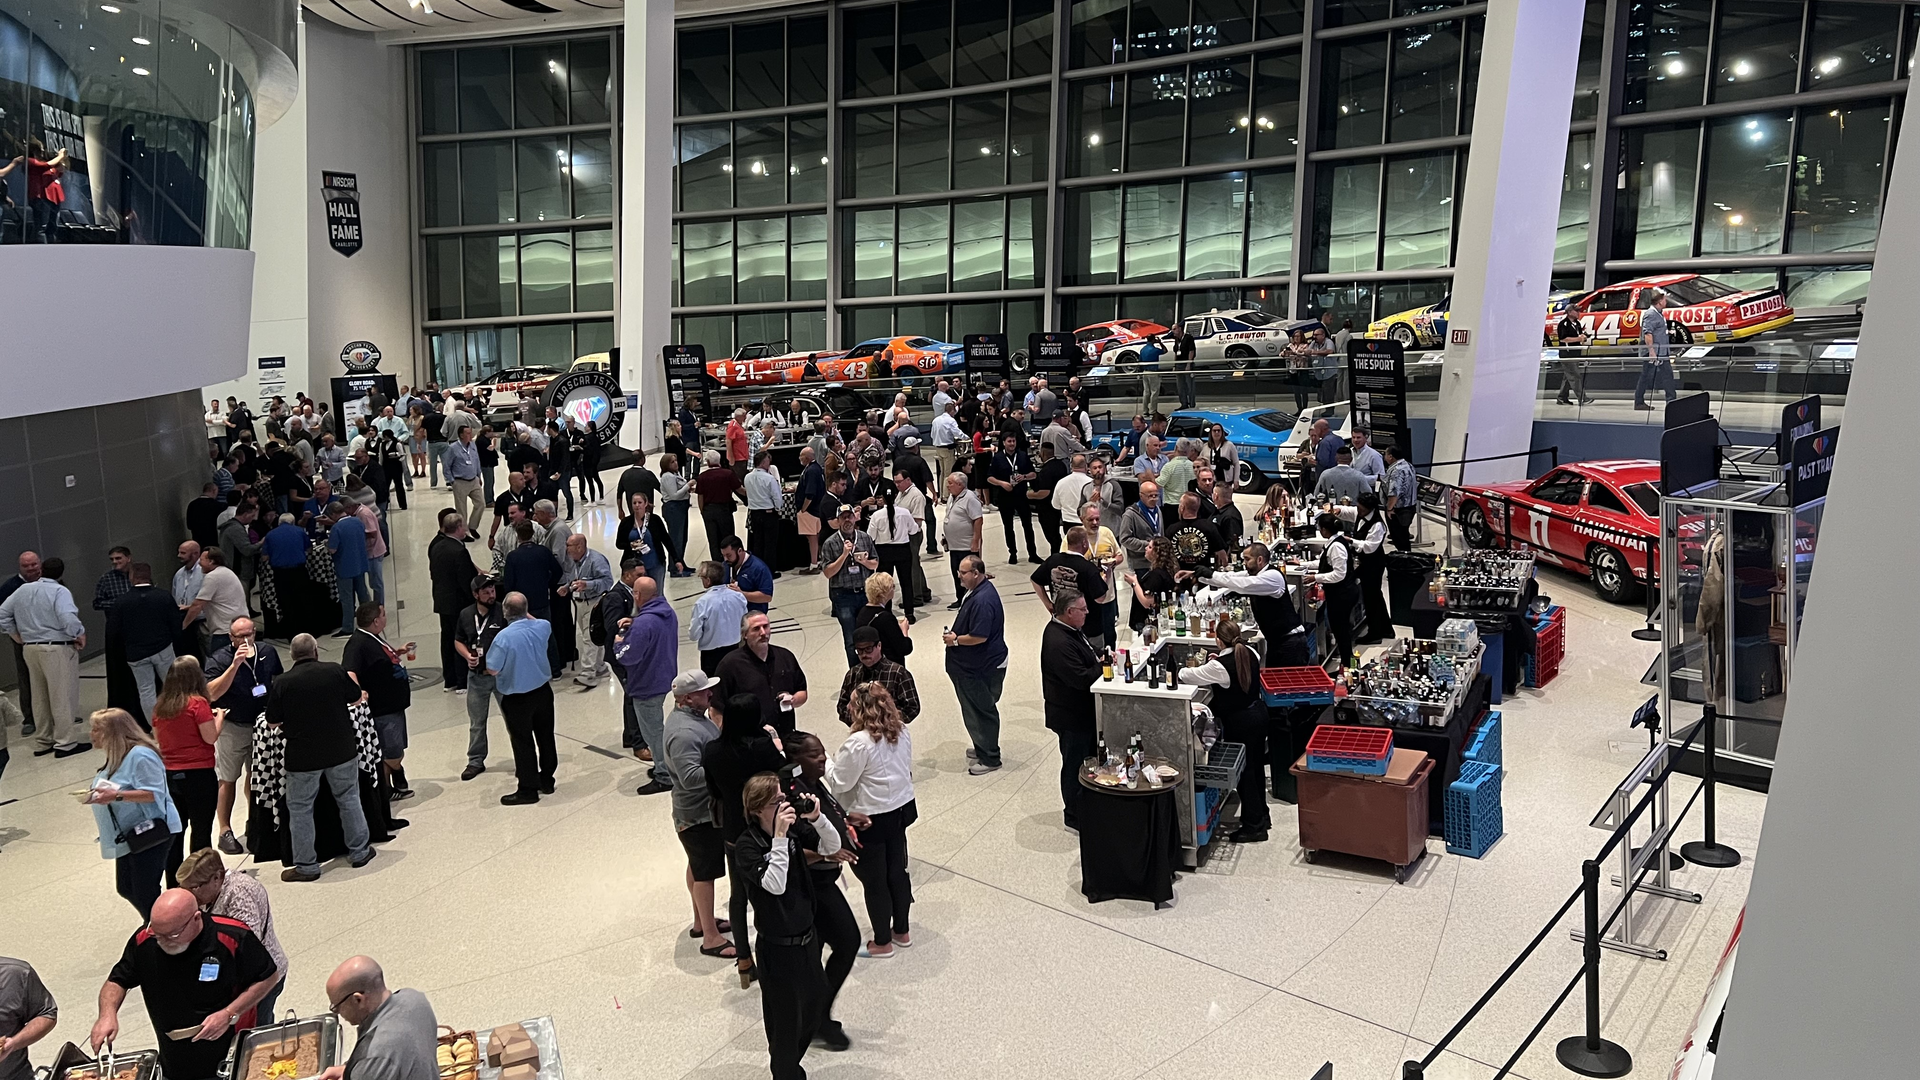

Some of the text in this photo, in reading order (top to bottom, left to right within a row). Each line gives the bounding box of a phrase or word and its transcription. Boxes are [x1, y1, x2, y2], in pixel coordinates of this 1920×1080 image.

[332, 176, 355, 189] NASCAR
[328, 202, 358, 218] HALL
[331, 224, 360, 240] FAME
[1742, 296, 1781, 317] PENROSE
[1662, 307, 1714, 324] NROSE
[1233, 331, 1266, 340] NEWTON
[1453, 331, 1467, 343] EXIT
[970, 347, 1000, 356] HERITAGE
[1040, 346, 1062, 355] SPORT
[668, 356, 700, 365] THE BEACH
[918, 356, 936, 369] STP
[1353, 358, 1395, 371] THE SPORT
[735, 363, 755, 381] 21
[843, 361, 868, 379] 43
[556, 374, 616, 401] NASCAR 75TH
[614, 401, 626, 409] 2023
[597, 415, 620, 441] SARY
[1798, 461, 1816, 482] PAST
[1183, 526, 1209, 558] DETERMINED
